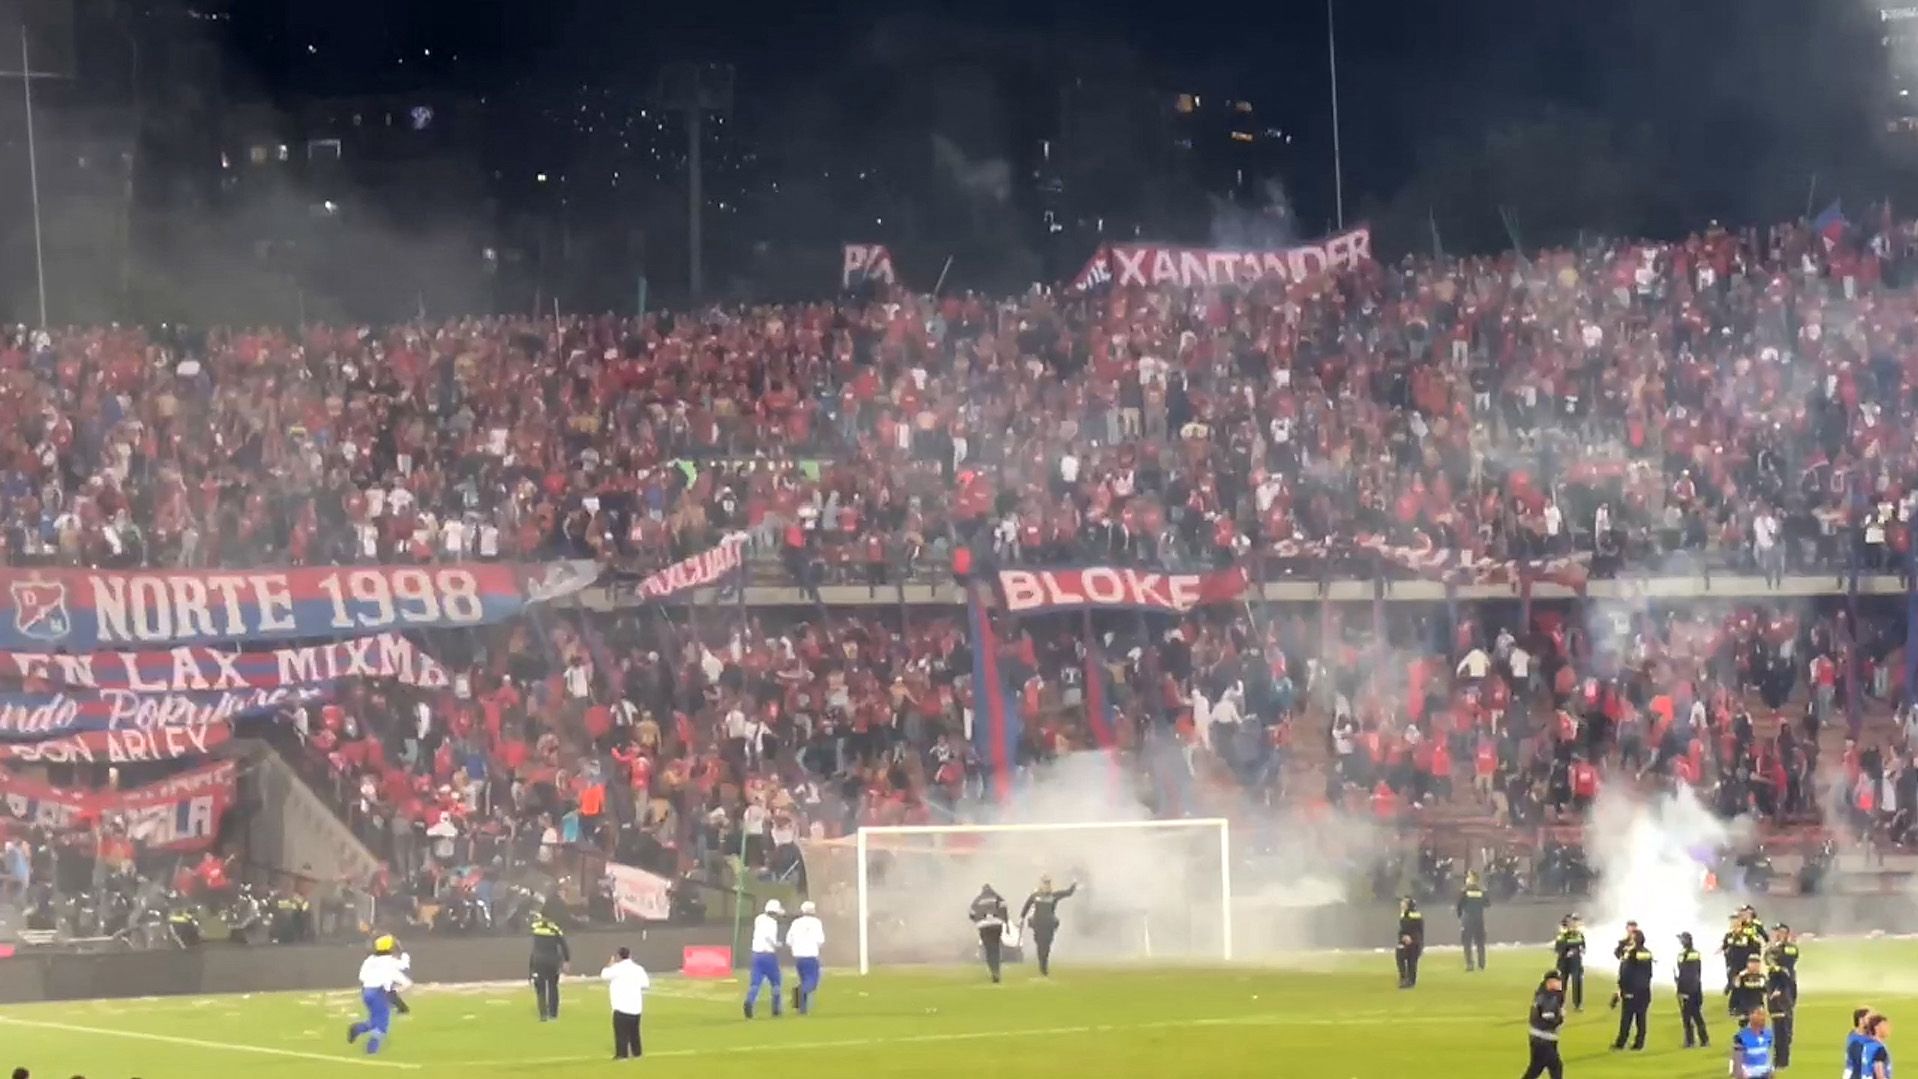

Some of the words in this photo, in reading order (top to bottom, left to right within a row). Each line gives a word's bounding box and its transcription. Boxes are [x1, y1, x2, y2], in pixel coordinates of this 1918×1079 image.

[89, 574, 296, 641] NORTE
[318, 568, 484, 629] 1998
[999, 566, 1200, 613] BLOKE
[118, 646, 251, 691] LAX
